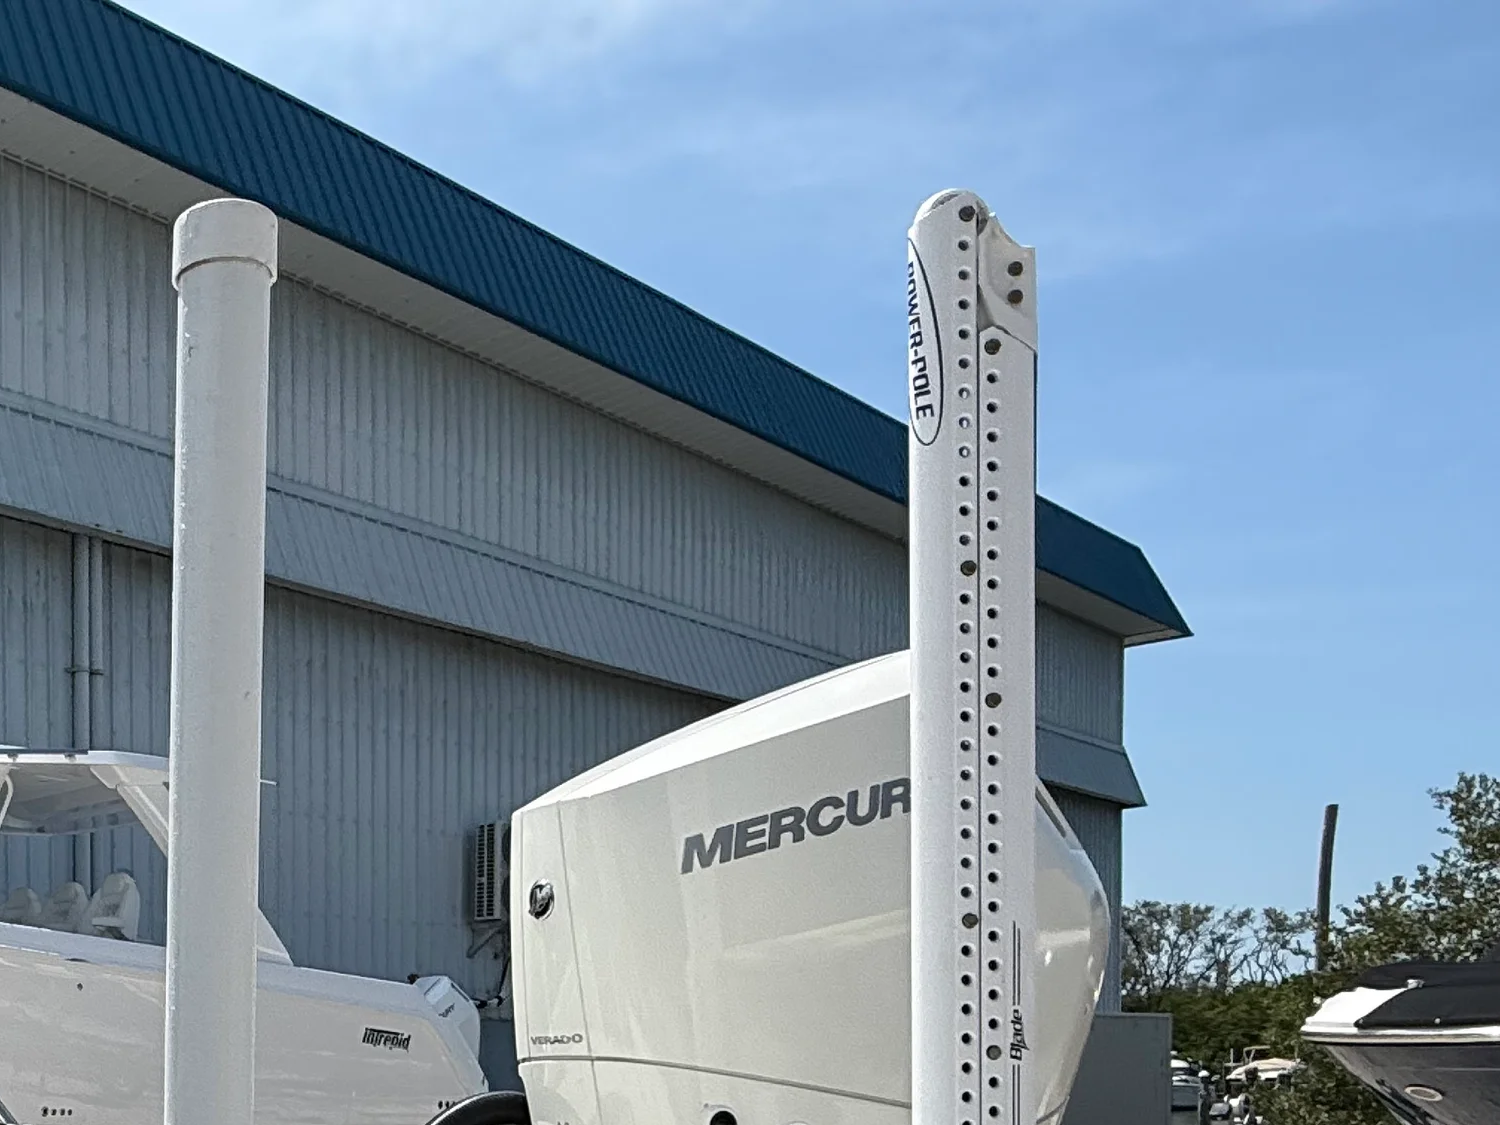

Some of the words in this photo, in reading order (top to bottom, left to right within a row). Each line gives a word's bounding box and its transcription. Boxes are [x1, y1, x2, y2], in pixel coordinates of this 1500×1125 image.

[681, 777, 912, 875] MERCUR
[530, 1033, 583, 1046] VERADO
[1009, 1008, 1030, 1061] Blade
